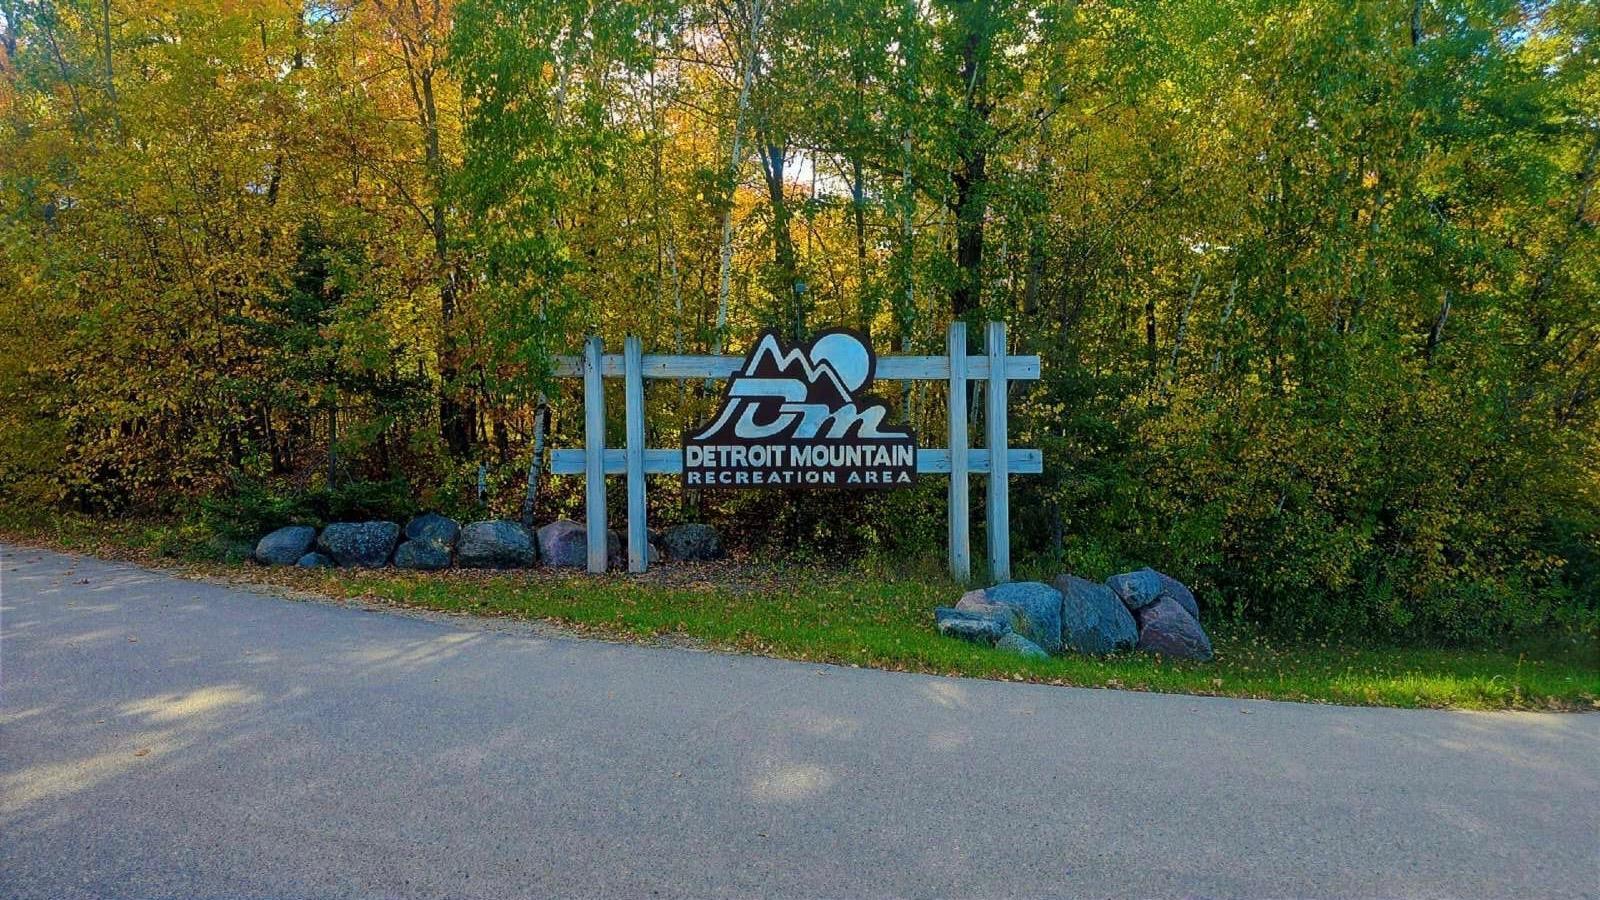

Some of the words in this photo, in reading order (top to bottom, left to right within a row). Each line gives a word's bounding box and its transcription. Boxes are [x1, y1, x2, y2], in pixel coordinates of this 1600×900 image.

[686, 445, 788, 467] DETROIT
[790, 445, 914, 467] MOUNTAIN
[687, 471, 836, 484] RECREATION
[847, 471, 912, 484] AREA
